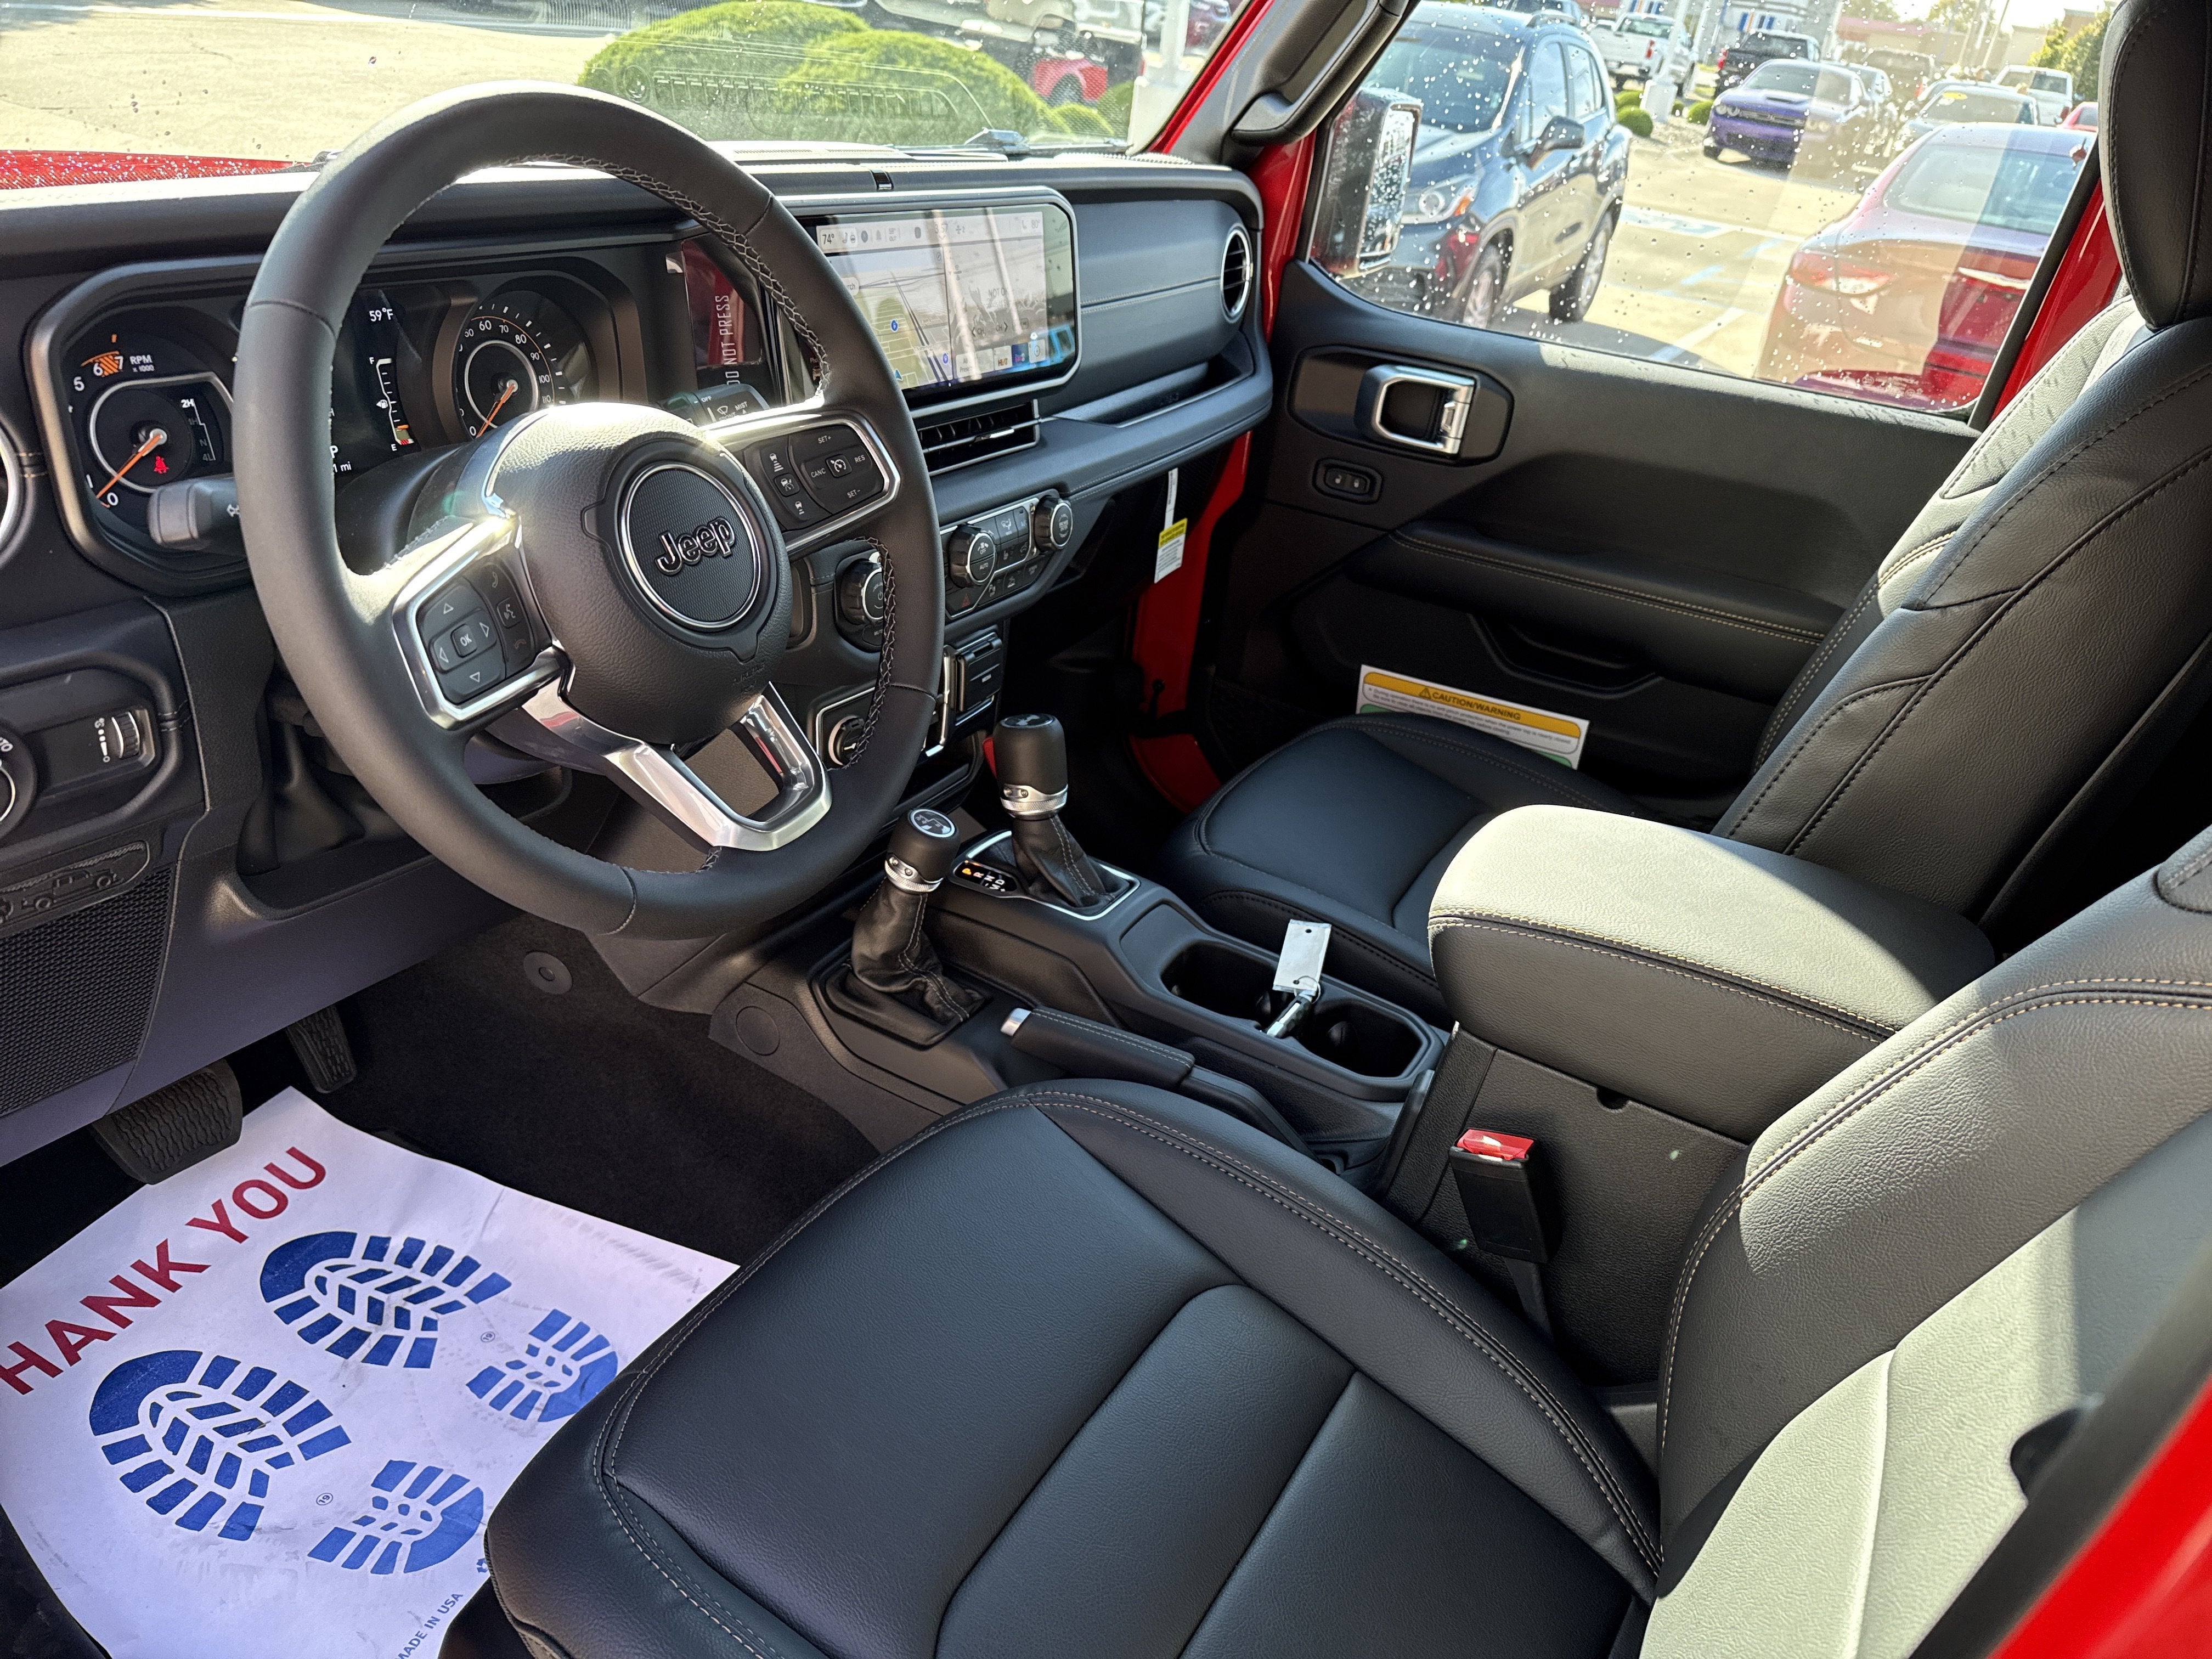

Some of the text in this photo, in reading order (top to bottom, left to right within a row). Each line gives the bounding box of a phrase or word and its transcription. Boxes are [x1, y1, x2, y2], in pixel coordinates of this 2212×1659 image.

[369, 307, 393, 322] 59°F
[715, 295, 733, 336] PRESS
[479, 320, 492, 331] 60
[499, 325, 509, 334] 70
[515, 334, 527, 344] 80
[129, 354, 153, 365] RPM
[530, 352, 540, 360] 90
[721, 342, 738, 365] NOT
[114, 356, 124, 370] 7
[93, 363, 103, 376] 6
[74, 376, 84, 391] 5
[538, 374, 550, 383] 100
[180, 398, 194, 408] 2H
[542, 394, 551, 403] 110
[735, 401, 747, 411] MIST
[469, 426, 476, 436] 0
[329, 445, 338, 459] P
[854, 454, 866, 463] RES
[340, 461, 352, 472] mi
[810, 467, 826, 478] CANC
[107, 492, 119, 506] 0
[654, 517, 736, 576] Jeep
[460, 633, 472, 646] OK
[1432, 692, 1521, 721] CAUTION/WARNING
[0, 1146, 326, 1396] HANK YOU
[394, 1594, 464, 1659] MADE IN USA
